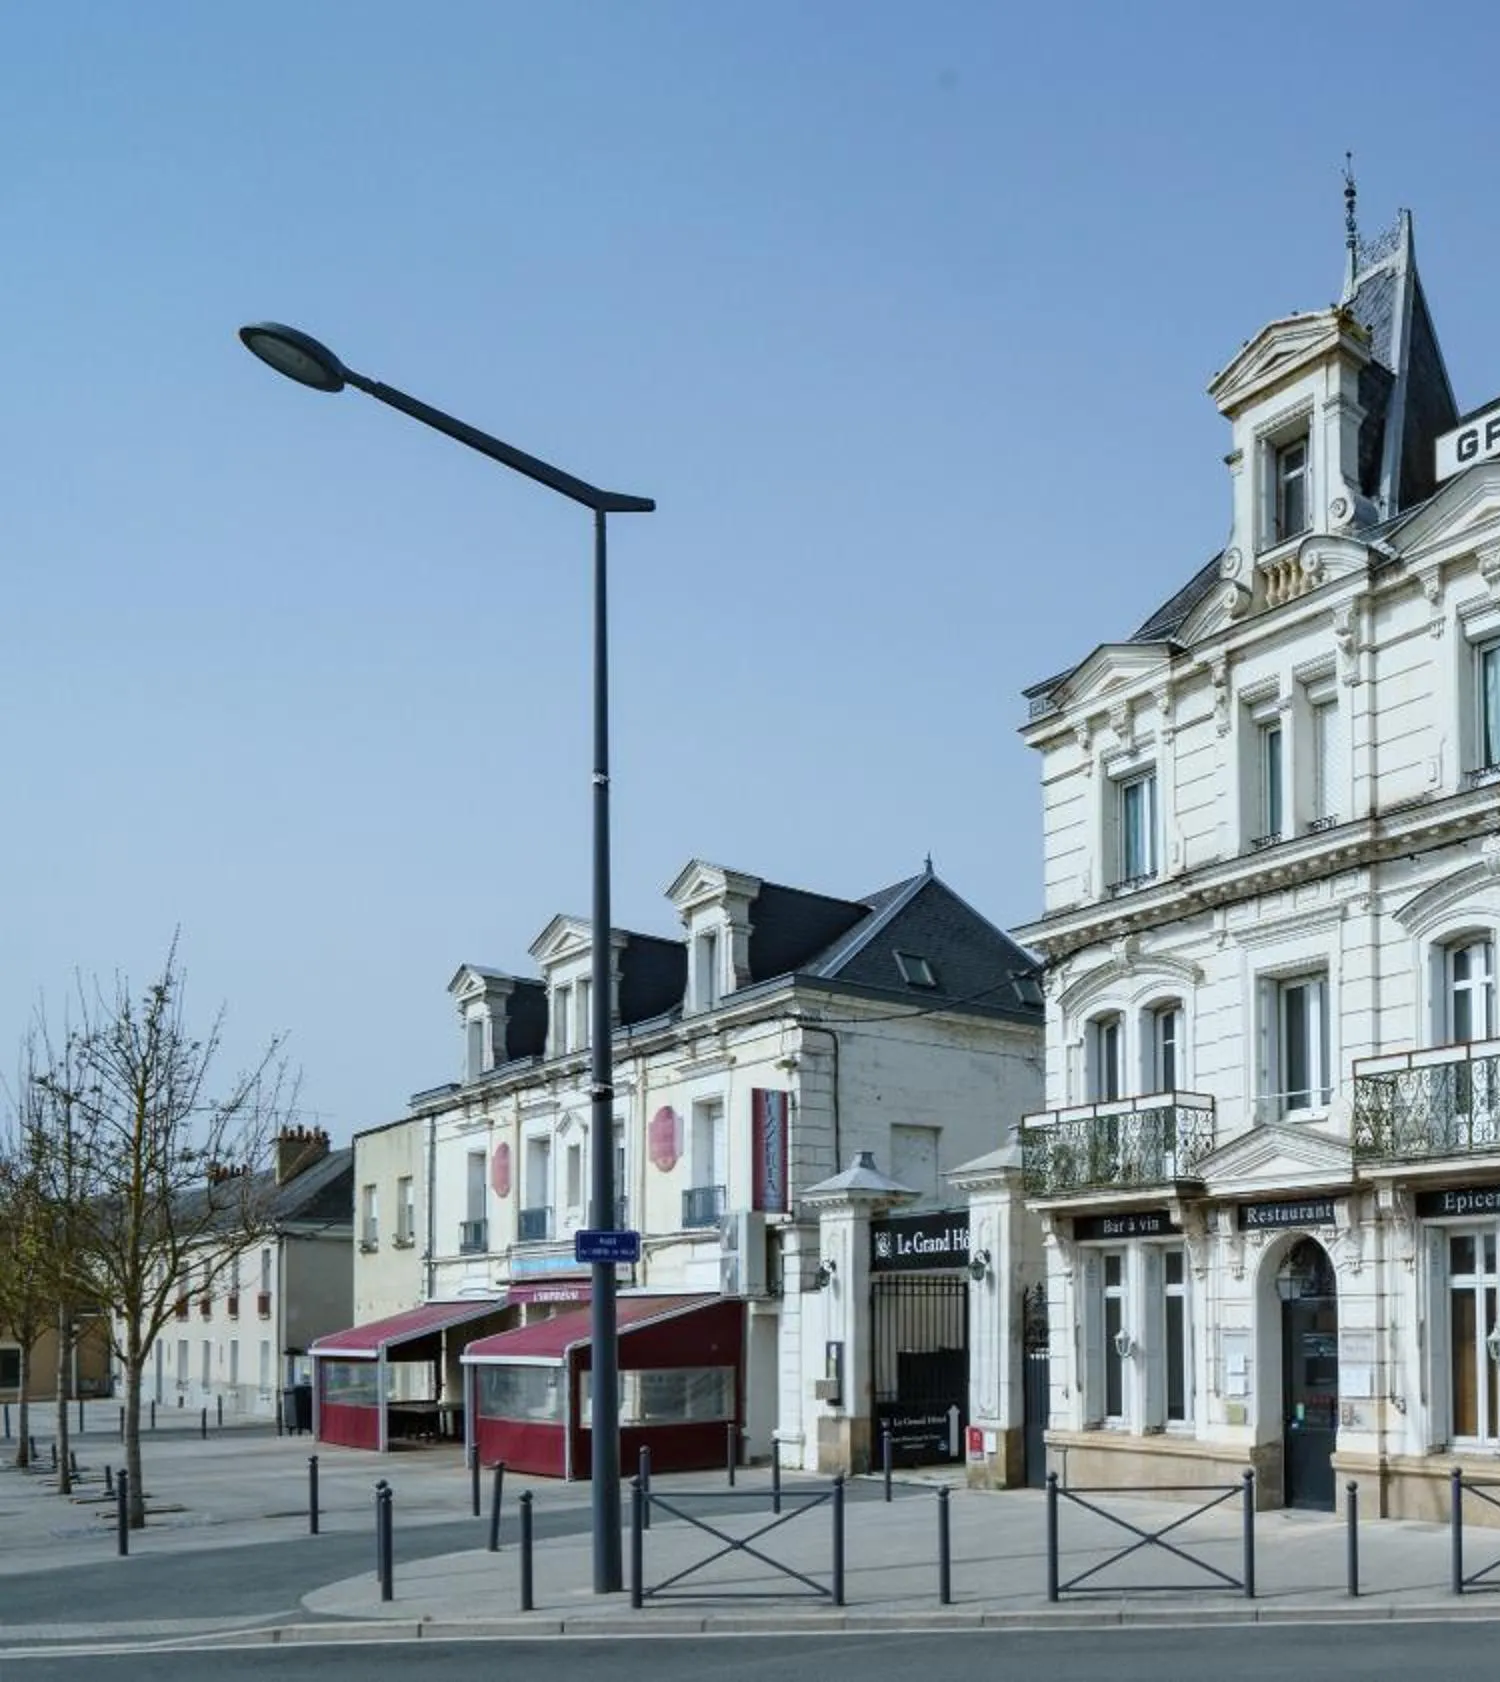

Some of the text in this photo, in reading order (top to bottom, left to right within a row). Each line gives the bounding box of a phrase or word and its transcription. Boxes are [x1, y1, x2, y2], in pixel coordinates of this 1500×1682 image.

[1102, 1218, 1125, 1233] Bar
[1139, 1216, 1160, 1231] vin
[1246, 1200, 1335, 1225] Restaurant
[896, 1232, 912, 1255] Le
[913, 1228, 951, 1254] Grand
